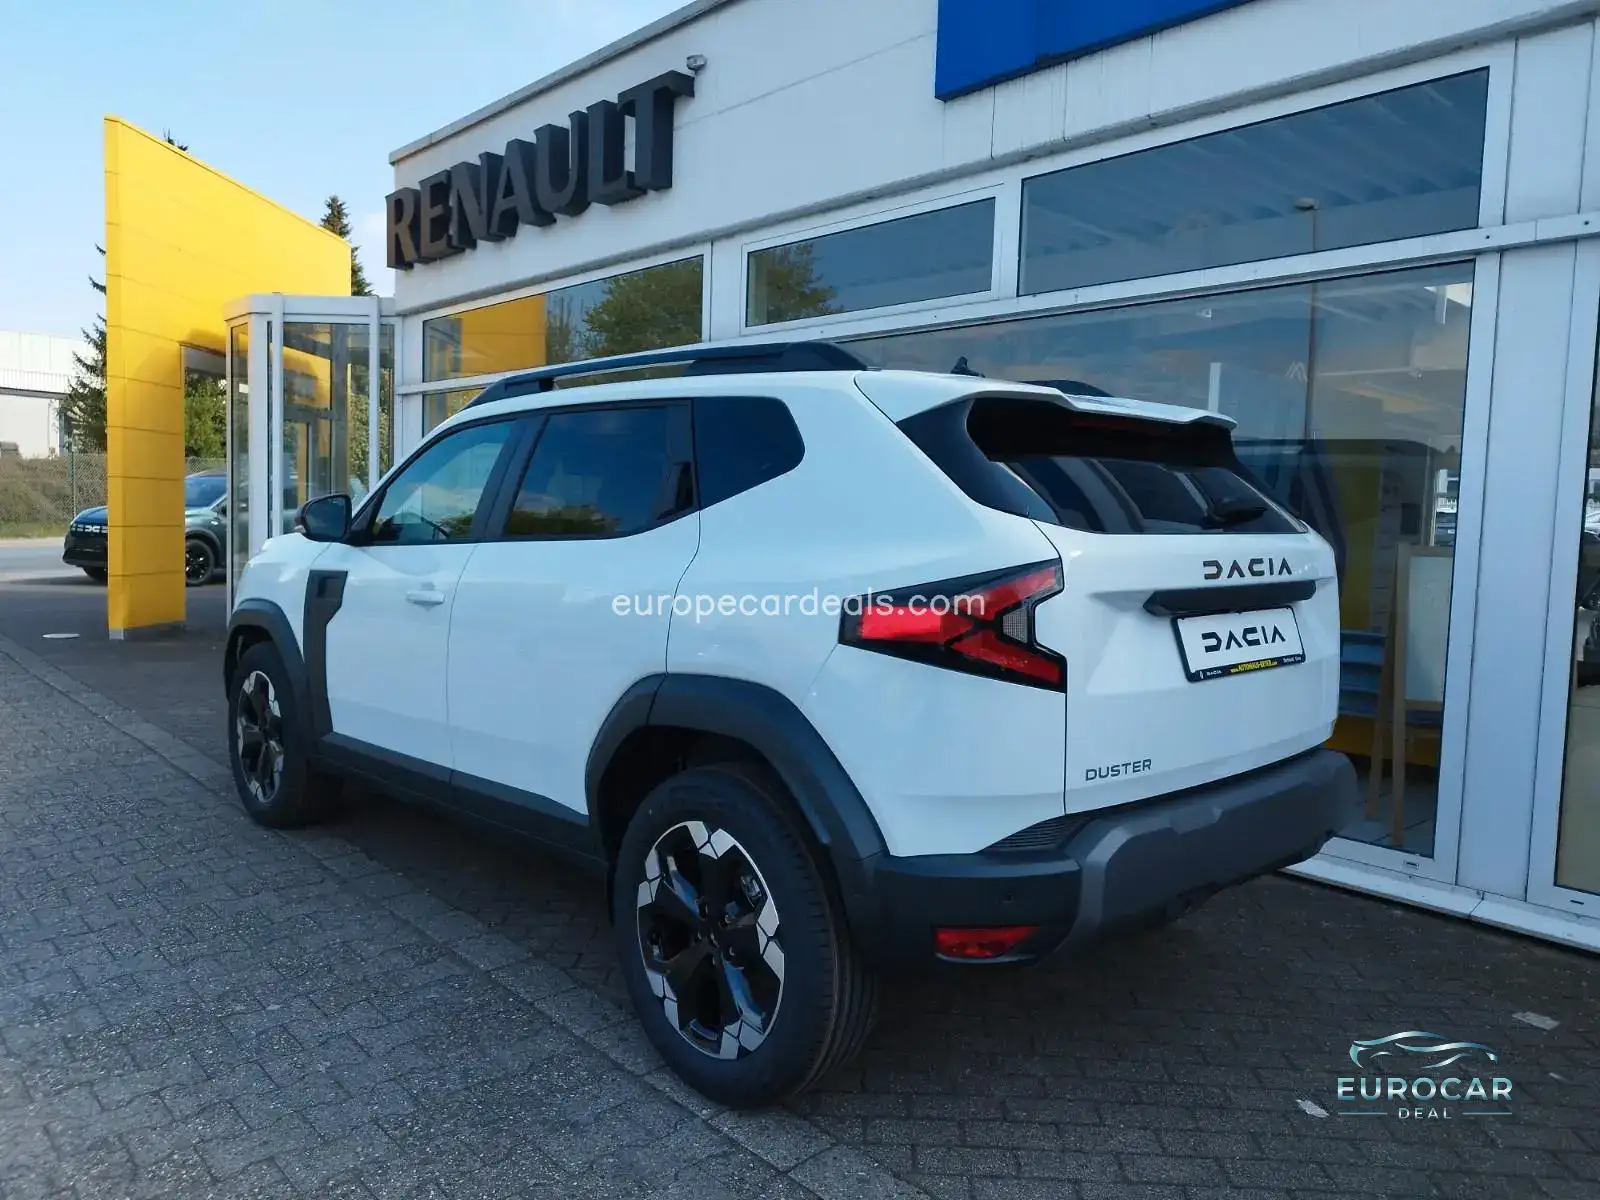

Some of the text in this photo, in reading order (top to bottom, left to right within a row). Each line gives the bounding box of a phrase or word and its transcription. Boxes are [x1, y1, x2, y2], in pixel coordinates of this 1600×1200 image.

[385, 70, 695, 271] RENAULT
[1203, 557, 1292, 580] DACIA
[1201, 625, 1286, 653] DACIA
[1085, 758, 1152, 781] DUSTER
